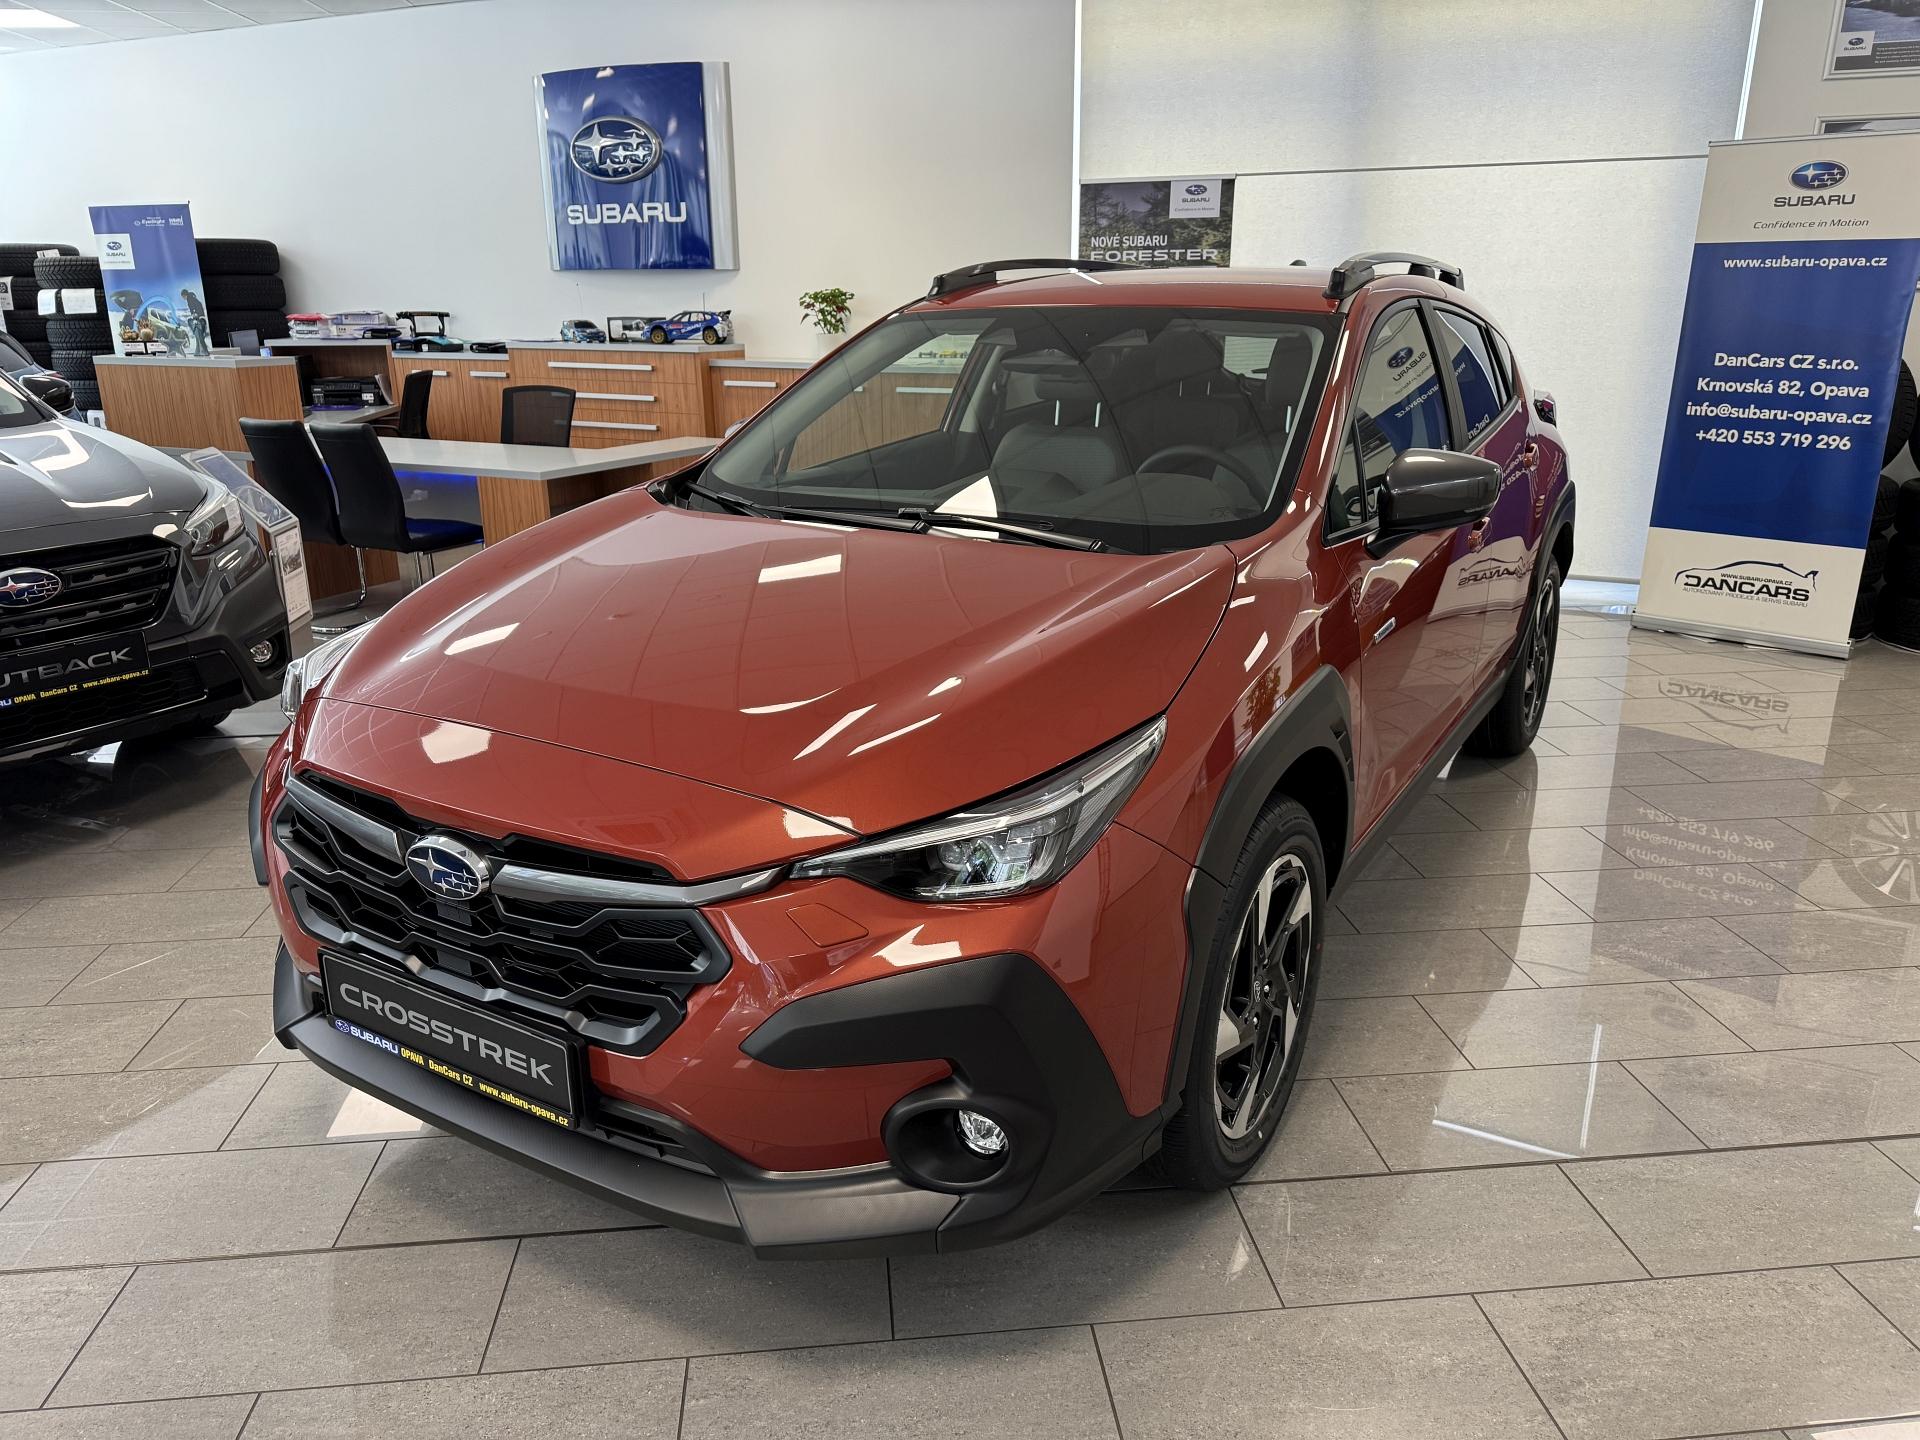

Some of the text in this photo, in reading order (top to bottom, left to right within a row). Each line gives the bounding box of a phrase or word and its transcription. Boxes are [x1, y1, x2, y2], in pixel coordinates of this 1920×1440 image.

[1773, 193, 1856, 208] SUBARU
[567, 202, 687, 225] SUBARU
[1753, 218, 1869, 229] Confidence in Motion
[1091, 233, 1168, 248] NOVÉ SUBARU
[1090, 249, 1218, 262] FORESTER
[1723, 255, 1888, 269] www.subaru-opava.cz
[1714, 352, 1859, 371] DanCars CZ s.r.o.
[1697, 377, 1869, 400] Krnovská 82, Opava
[1686, 402, 1872, 425] info@subaru-opava.cz
[1695, 429, 1851, 451] +420 553 719 296
[1683, 574, 1810, 602] DANCARS
[1720, 572, 1793, 587] WWW.SUBARU-OPAVA.CZ
[1783, 599, 1809, 608] SUBARU
[14, 693, 37, 704] OPAVA
[40, 687, 68, 698] DanCars
[69, 684, 79, 692] CZ
[82, 669, 150, 689] www.subaru-opava.cz
[339, 983, 555, 1087] CROSSTREK
[350, 1025, 569, 1127] SUBARU OPAVA DanCars CZ www.subaru-opava.cz
